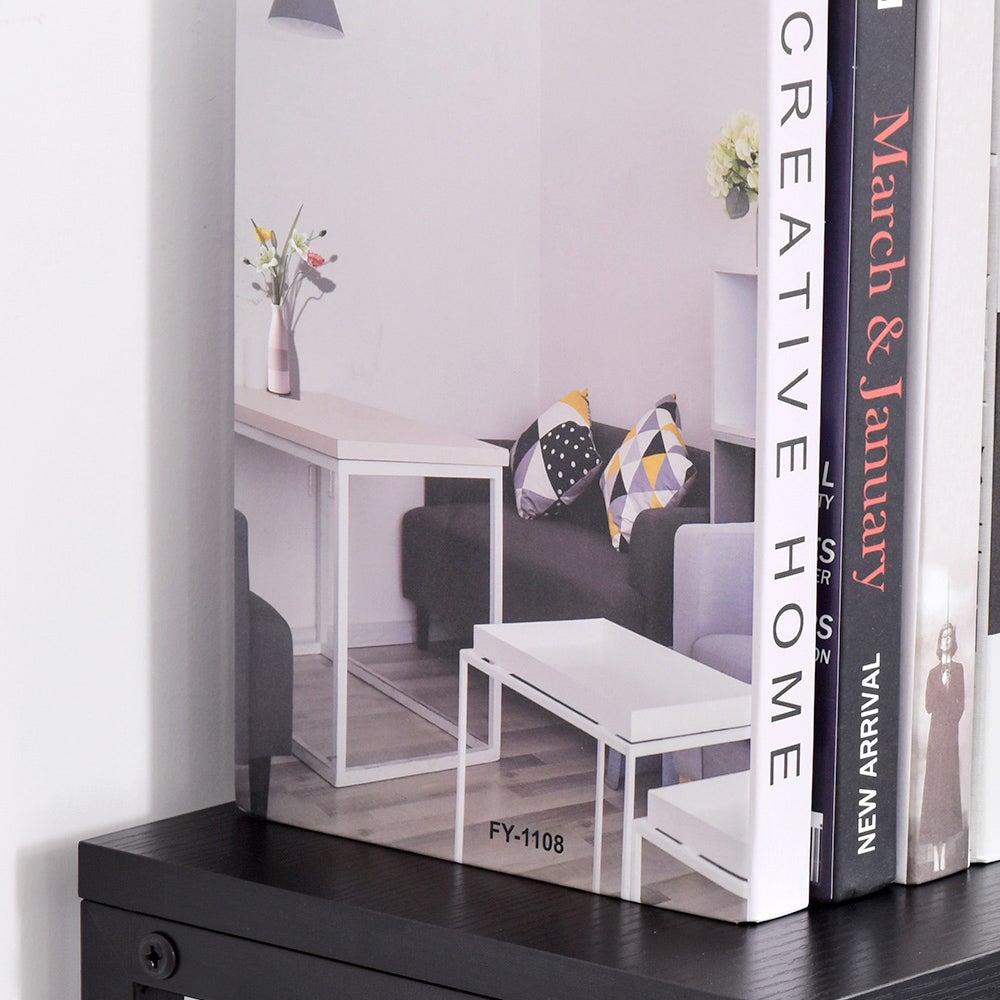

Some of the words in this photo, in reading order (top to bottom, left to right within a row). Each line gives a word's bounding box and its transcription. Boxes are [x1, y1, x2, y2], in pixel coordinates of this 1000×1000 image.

[775, 11, 815, 479] CREATIVE
[869, 107, 910, 297] March
[866, 315, 904, 363] &
[851, 376, 904, 593] January
[769, 535, 806, 786] HOME
[858, 651, 882, 779] ARRIVAL
[489, 819, 565, 854] FY-1108
[857, 788, 879, 856] NEW
